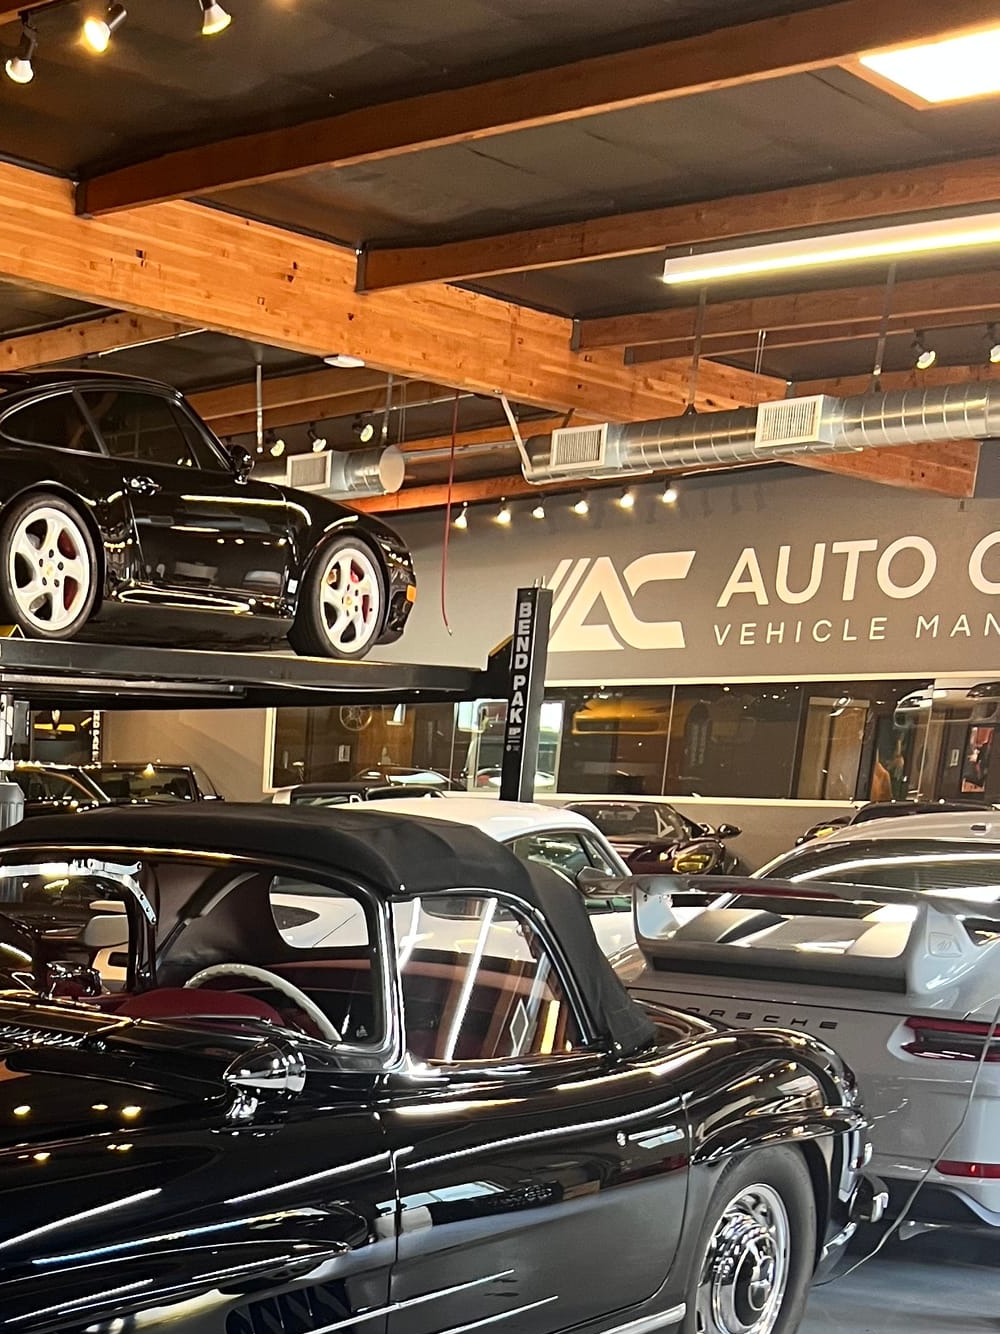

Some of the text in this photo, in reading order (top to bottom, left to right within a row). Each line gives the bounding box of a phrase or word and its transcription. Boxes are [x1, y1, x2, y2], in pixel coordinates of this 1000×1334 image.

[716, 536, 938, 607] AUTO
[714, 617, 887, 646] VEHICLE
[510, 602, 532, 723] BEND PAK
[687, 1007, 839, 1030] RSCHE
